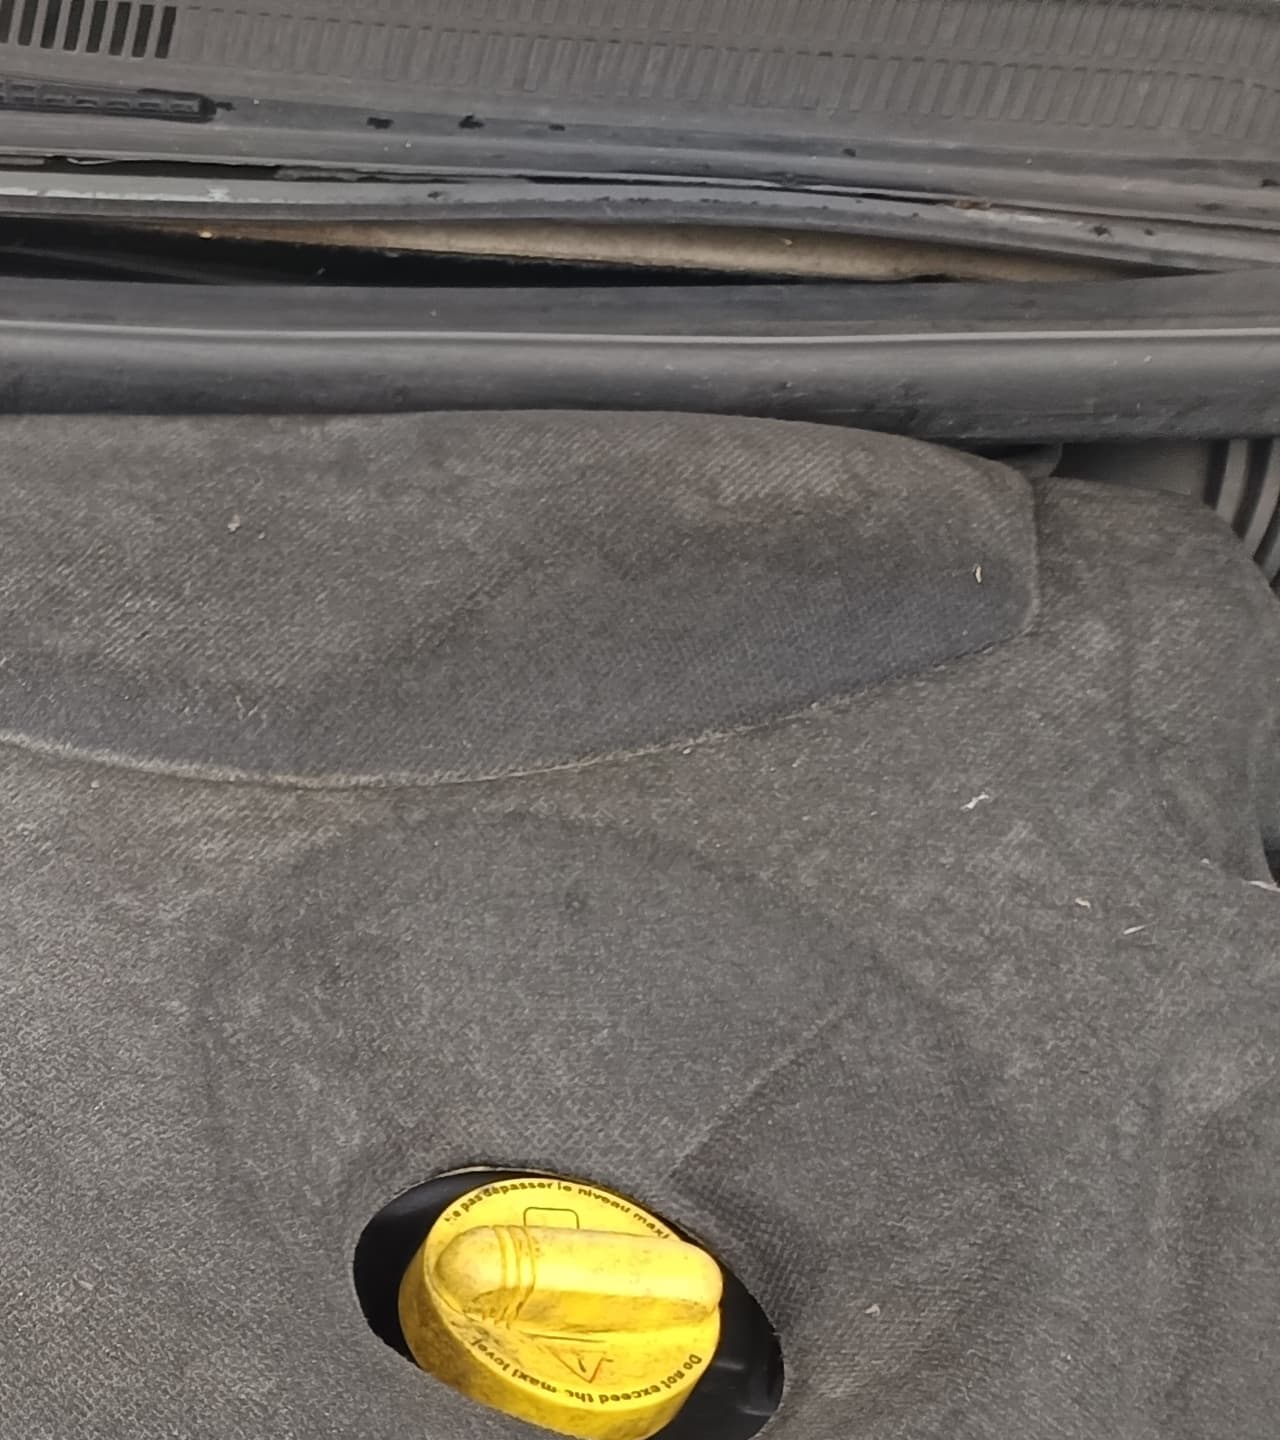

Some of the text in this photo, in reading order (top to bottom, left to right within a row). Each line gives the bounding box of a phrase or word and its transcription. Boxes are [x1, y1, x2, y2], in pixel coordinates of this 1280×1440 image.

[577, 1187, 631, 1213] niveau
[632, 1211, 671, 1240] maxi
[683, 1353, 703, 1371] Do
[511, 1368, 557, 1394] maxi
[661, 1368, 686, 1390] not
[598, 1385, 662, 1404] exceed
